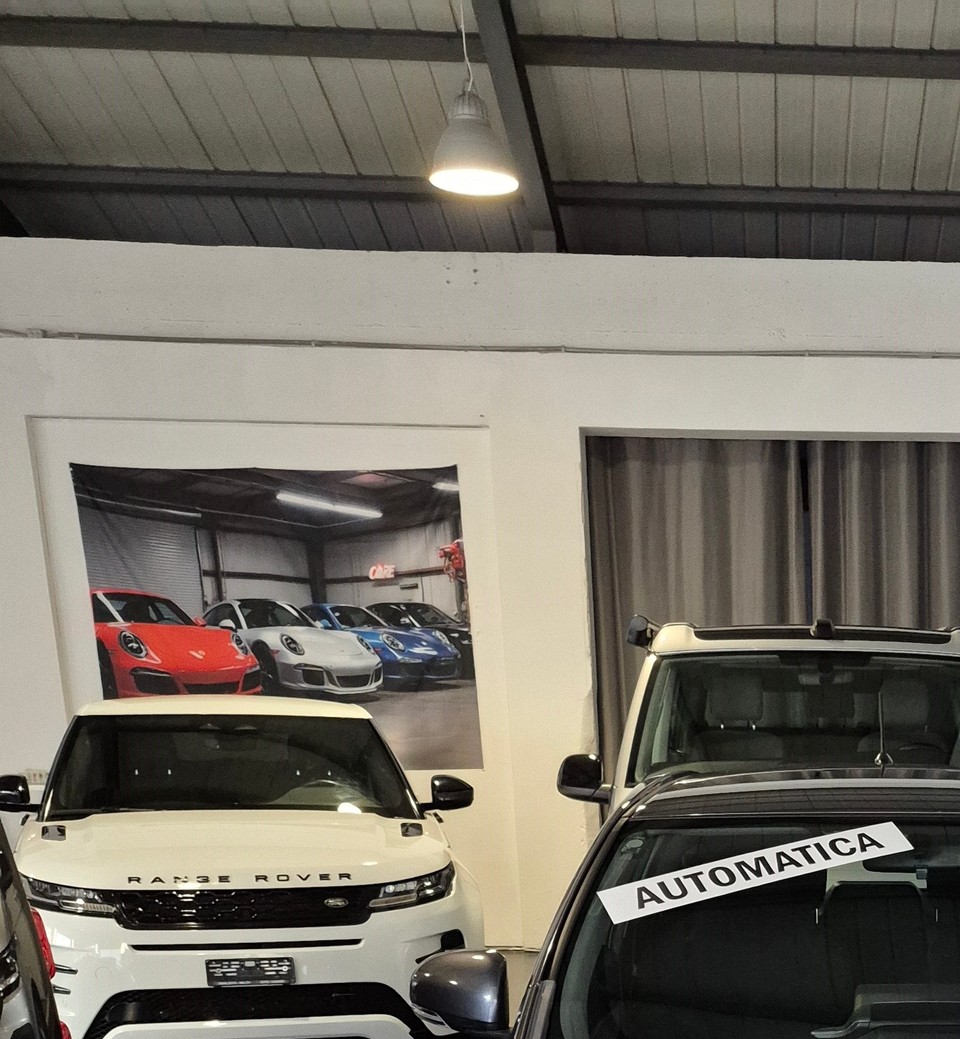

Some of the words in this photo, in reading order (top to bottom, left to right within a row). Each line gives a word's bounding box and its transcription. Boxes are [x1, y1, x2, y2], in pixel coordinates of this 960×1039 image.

[127, 875, 231, 884] RANGE
[255, 873, 352, 882] ROVER
[636, 832, 885, 910] AUTOMATICA
